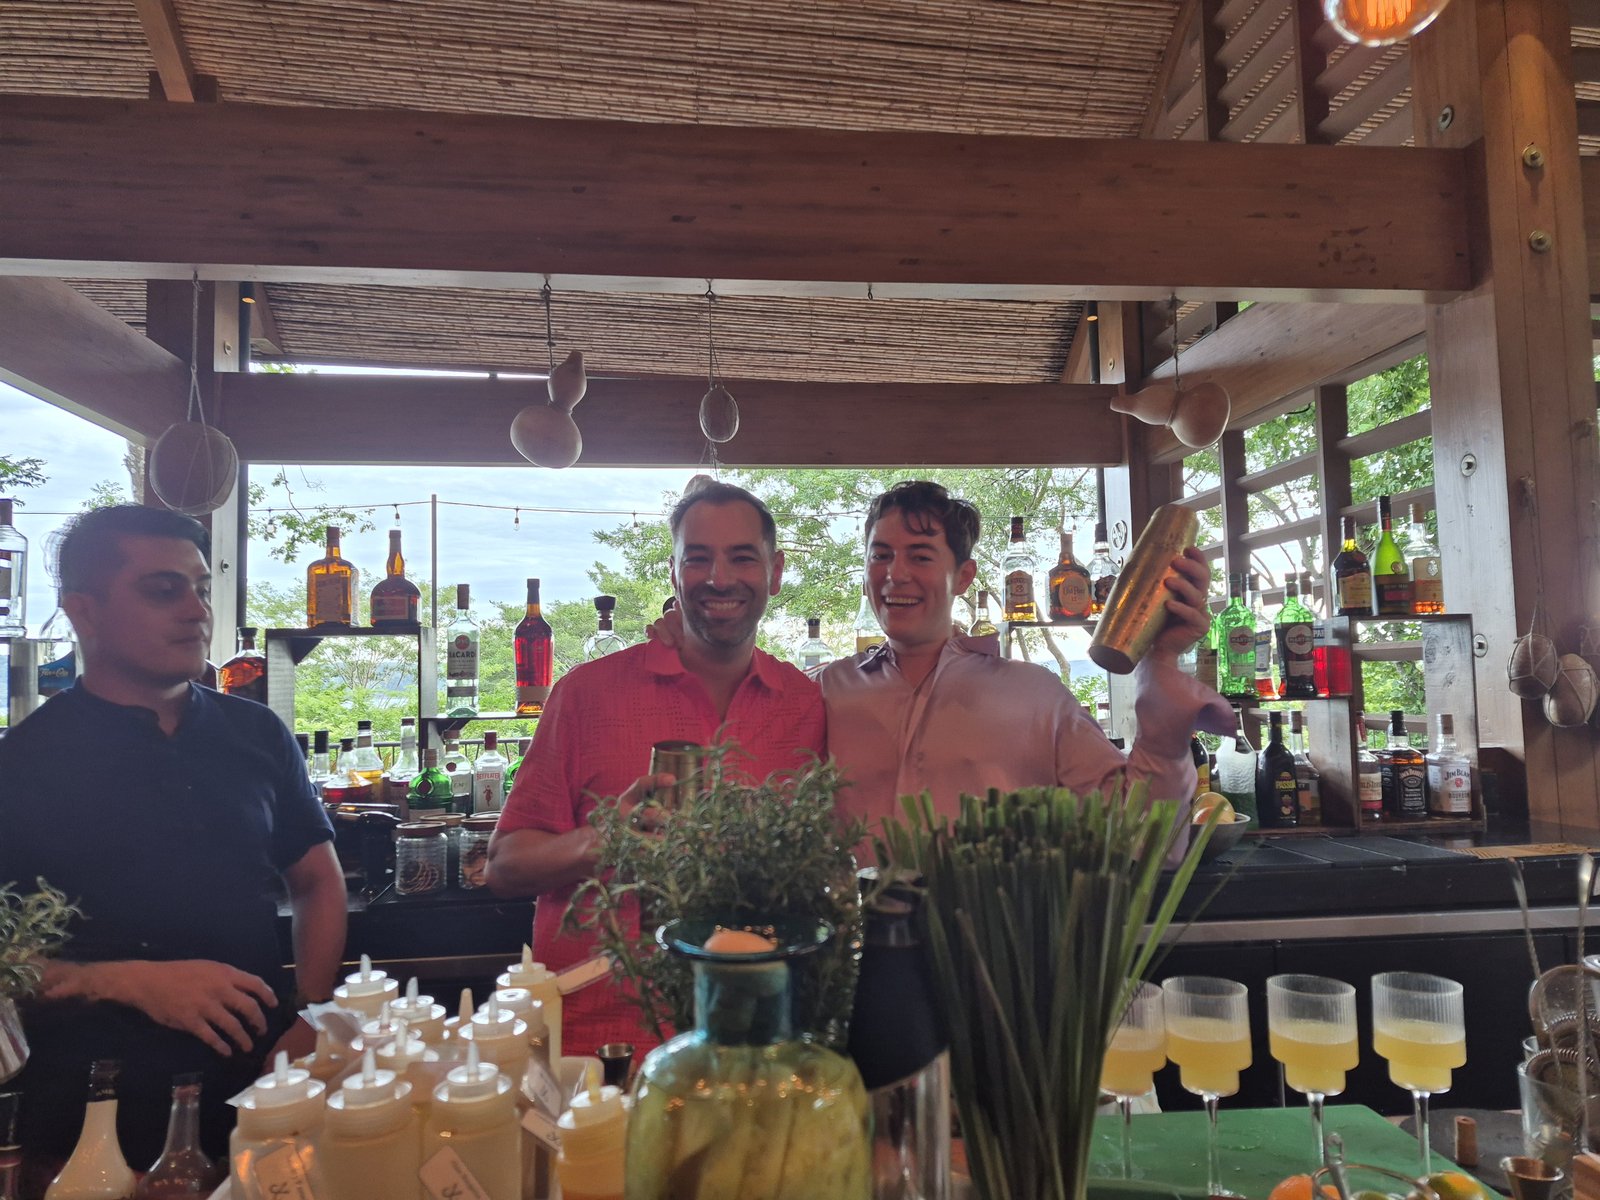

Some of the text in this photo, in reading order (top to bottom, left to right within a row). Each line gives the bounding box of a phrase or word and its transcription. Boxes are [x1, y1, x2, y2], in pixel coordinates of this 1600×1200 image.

[477, 772, 500, 781] BEEFEATER
[1444, 768, 1471, 781] JIM BEAM
